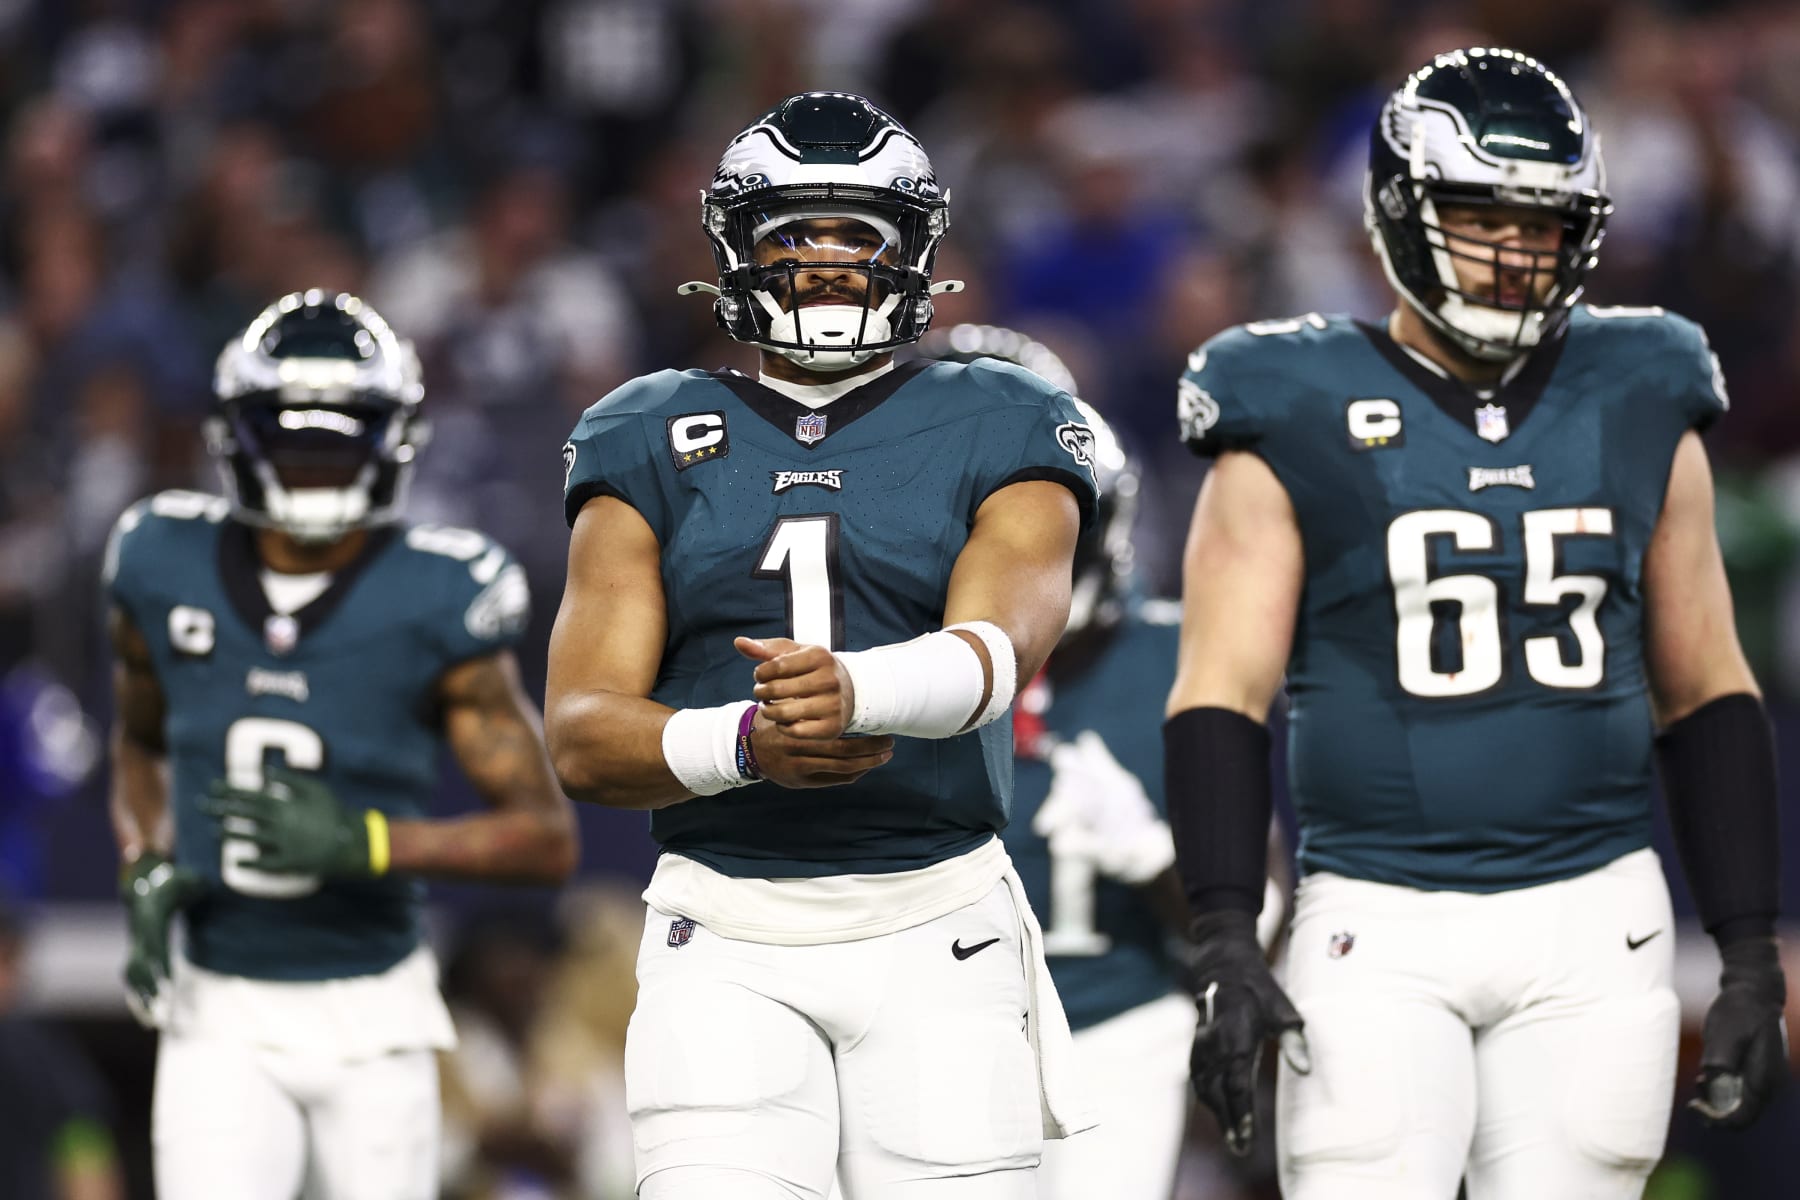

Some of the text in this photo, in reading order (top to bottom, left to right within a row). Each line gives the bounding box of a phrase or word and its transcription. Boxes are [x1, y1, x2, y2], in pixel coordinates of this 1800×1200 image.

[672, 413, 724, 453] C
[800, 425, 821, 436] NFL
[1348, 399, 1402, 439] C
[774, 470, 844, 492] EAGLES
[757, 514, 836, 652] 1
[1387, 508, 1612, 697] 65
[670, 929, 689, 943] NFL
